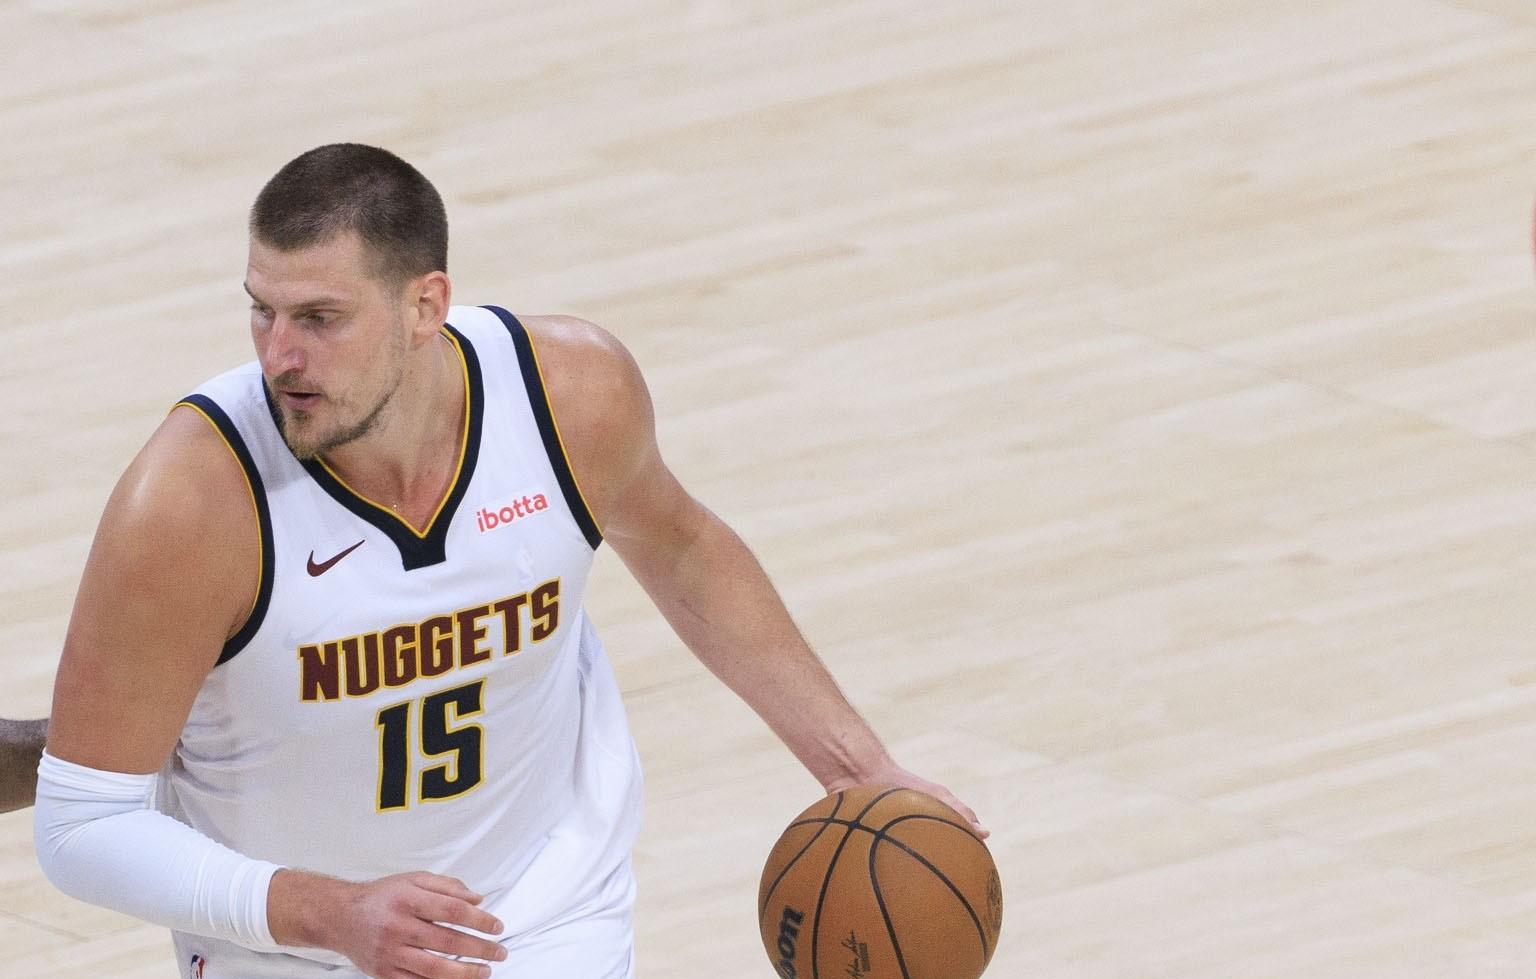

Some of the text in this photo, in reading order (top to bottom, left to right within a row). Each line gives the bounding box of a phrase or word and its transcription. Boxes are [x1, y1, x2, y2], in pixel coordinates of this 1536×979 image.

[476, 493, 548, 534] ibotta
[297, 576, 561, 703] NUGGETS
[375, 677, 487, 813] 15
